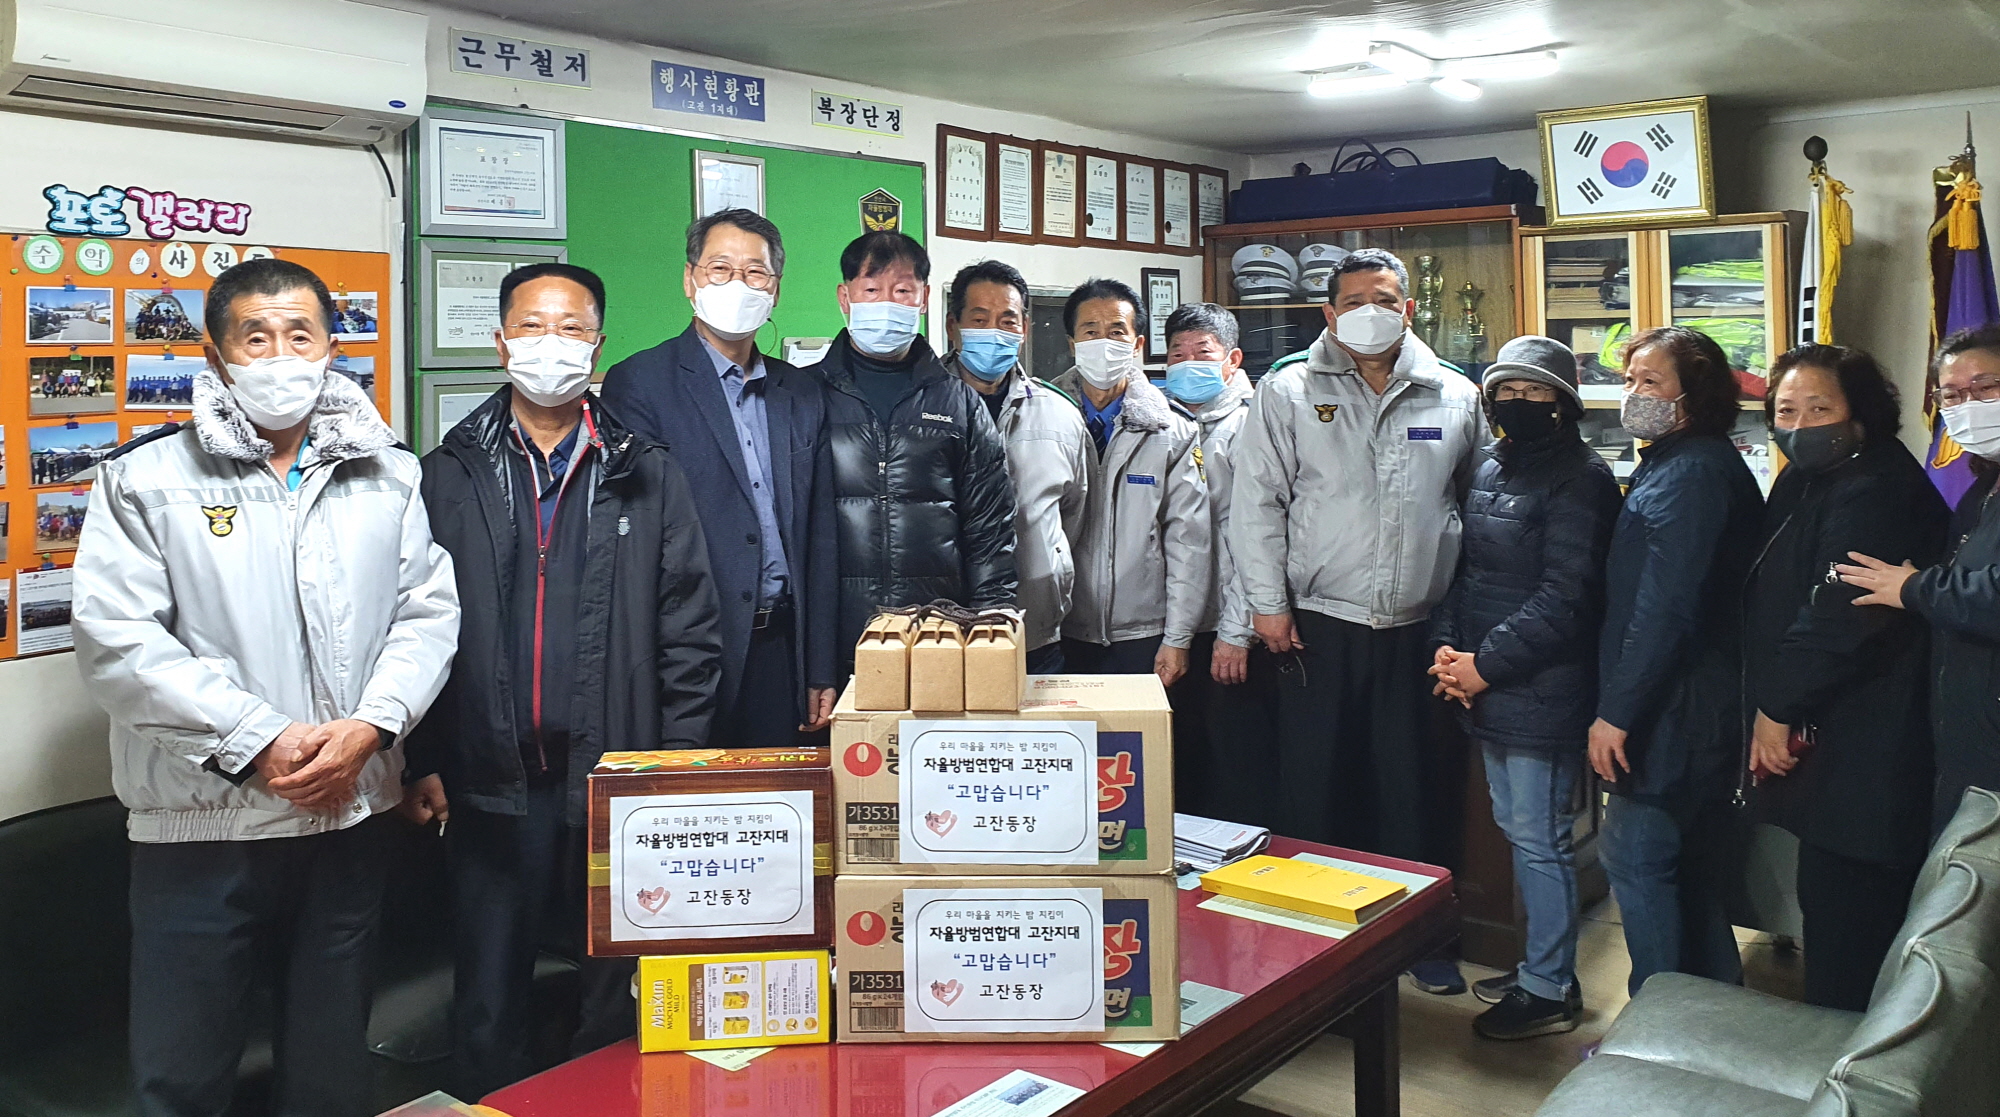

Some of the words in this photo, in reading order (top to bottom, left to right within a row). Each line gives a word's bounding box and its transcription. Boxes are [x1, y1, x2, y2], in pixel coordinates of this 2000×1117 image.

[458, 36, 586, 82] 근무철저
[659, 67, 761, 107] 행사현황판
[817, 96, 900, 132] 복장단정
[44, 184, 129, 235] 포토
[126, 187, 251, 239] 갤러리
[921, 412, 954, 423] Reebok
[939, 742, 956, 751] 우리
[960, 742, 986, 752] 마을을
[989, 742, 1015, 752] 지키는
[1019, 742, 1028, 752] 밤
[1032, 742, 1058, 752] 지킴이
[923, 757, 1014, 774] 자율방범연합대
[1021, 757, 1073, 773] 고잔지대
[947, 784, 1050, 803] “고맙습니다”
[652, 817, 669, 827] 우리
[674, 816, 699, 826] 마을을
[704, 815, 729, 825] 지키는
[734, 815, 743, 824] 밤
[747, 814, 772, 824] 지킴이
[848, 805, 898, 821] 가3531
[973, 816, 1037, 833] 고잔동장
[635, 831, 729, 849] 자율방범연합대
[736, 829, 789, 846] 고잔지대
[660, 857, 765, 878] “고맙습니다”
[686, 888, 752, 906] 고잔동장
[944, 910, 962, 919] 우리
[966, 910, 991, 920] 마을을
[996, 910, 1021, 920] 지키는
[1025, 910, 1034, 920] 밤
[1039, 910, 1064, 920] 지킴이
[929, 926, 1020, 942] 자율방범연합대
[1027, 926, 1080, 942] 고잔지대
[953, 953, 1057, 972] “고맙습니다”
[852, 974, 903, 990] 가3531
[979, 984, 1043, 1001] 고잔동장
[650, 979, 665, 1029] Maxim
